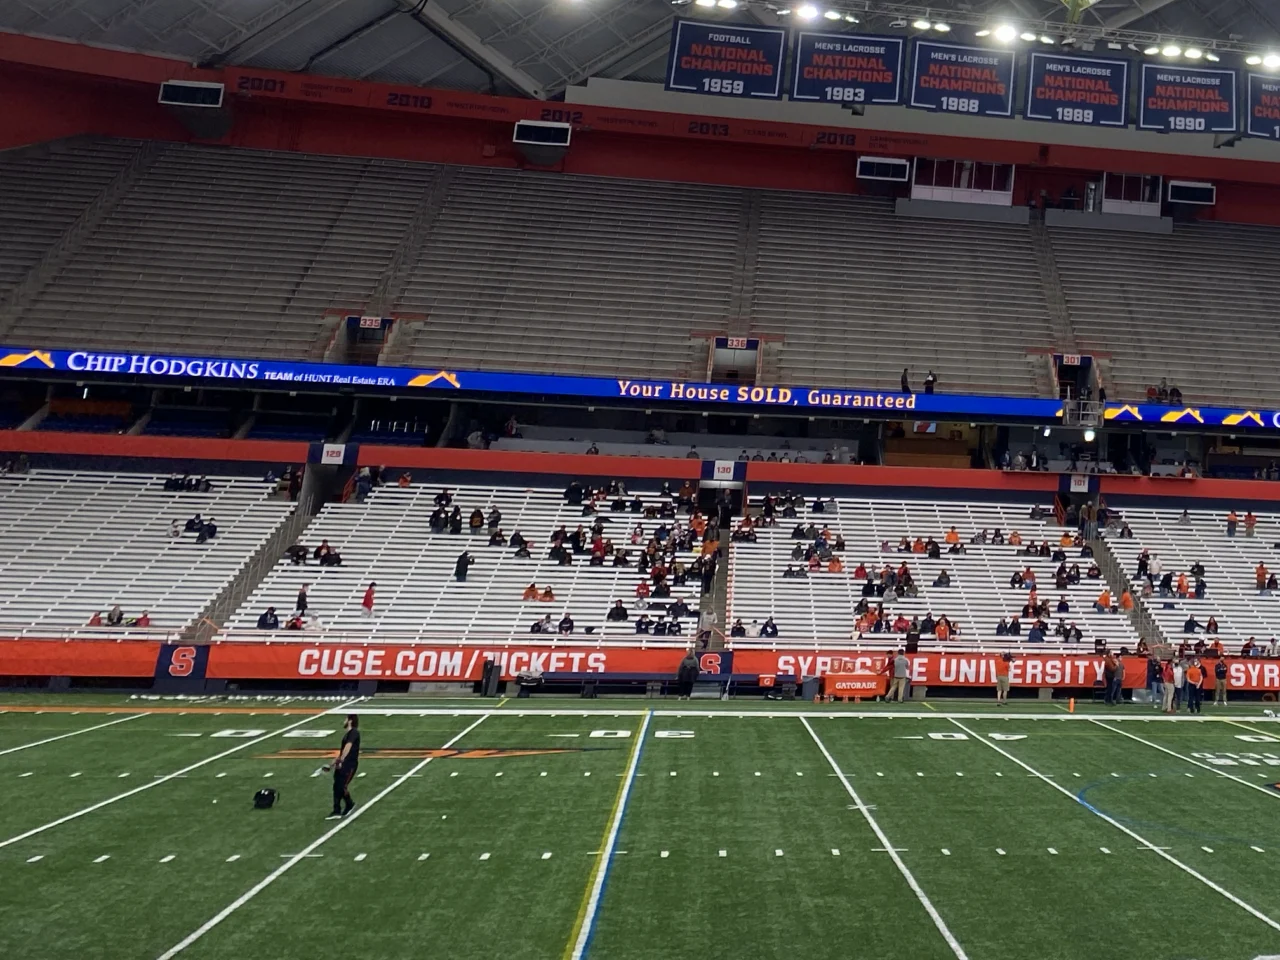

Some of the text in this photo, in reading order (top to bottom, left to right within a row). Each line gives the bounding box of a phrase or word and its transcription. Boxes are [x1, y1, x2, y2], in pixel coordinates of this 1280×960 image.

[708, 33, 751, 44] FOOTBALL
[690, 43, 766, 62] NATIONAL
[815, 42, 886, 54] MEN'S LACROSSE
[681, 56, 773, 76] CHAMPIONS
[812, 54, 886, 70] NATIONAL
[931, 52, 999, 66] MEN'S LACROSSE
[804, 66, 893, 83] CHAMPIONS
[928, 64, 999, 81] NATIONAL
[1046, 63, 1112, 76] MEN'S LACROSSE
[237, 76, 286, 93] 2001
[702, 78, 744, 94] 1959
[920, 76, 1006, 95] CHAMPIONS
[1044, 75, 1112, 92] NATIONAL
[1156, 74, 1220, 85] MEN'S LACROSSE
[825, 87, 865, 101] 1983
[1035, 87, 1119, 105] CHAMPIONS
[1156, 85, 1223, 100] NATIONAL
[387, 92, 433, 109] 2010
[941, 96, 979, 113] 1988
[1148, 98, 1230, 113] CHAMPIONS
[541, 109, 583, 124] 2012
[1056, 107, 1093, 123] 1989
[688, 122, 729, 136] 2013
[1168, 116, 1205, 131] 1990
[360, 319, 380, 327] 335
[728, 339, 746, 347] 336
[1065, 356, 1080, 364] 301
[264, 371, 292, 381] TEAM
[294, 373, 304, 381] of
[304, 374, 332, 383] HUNT
[333, 376, 350, 384] Real
[352, 376, 376, 385] Estate
[377, 378, 395, 386] ERA
[618, 380, 916, 409] Your House SOLD, Guaranteed
[169, 646, 196, 676] S
[777, 656, 928, 682] SYRCE
[835, 682, 877, 690] GATORADE
